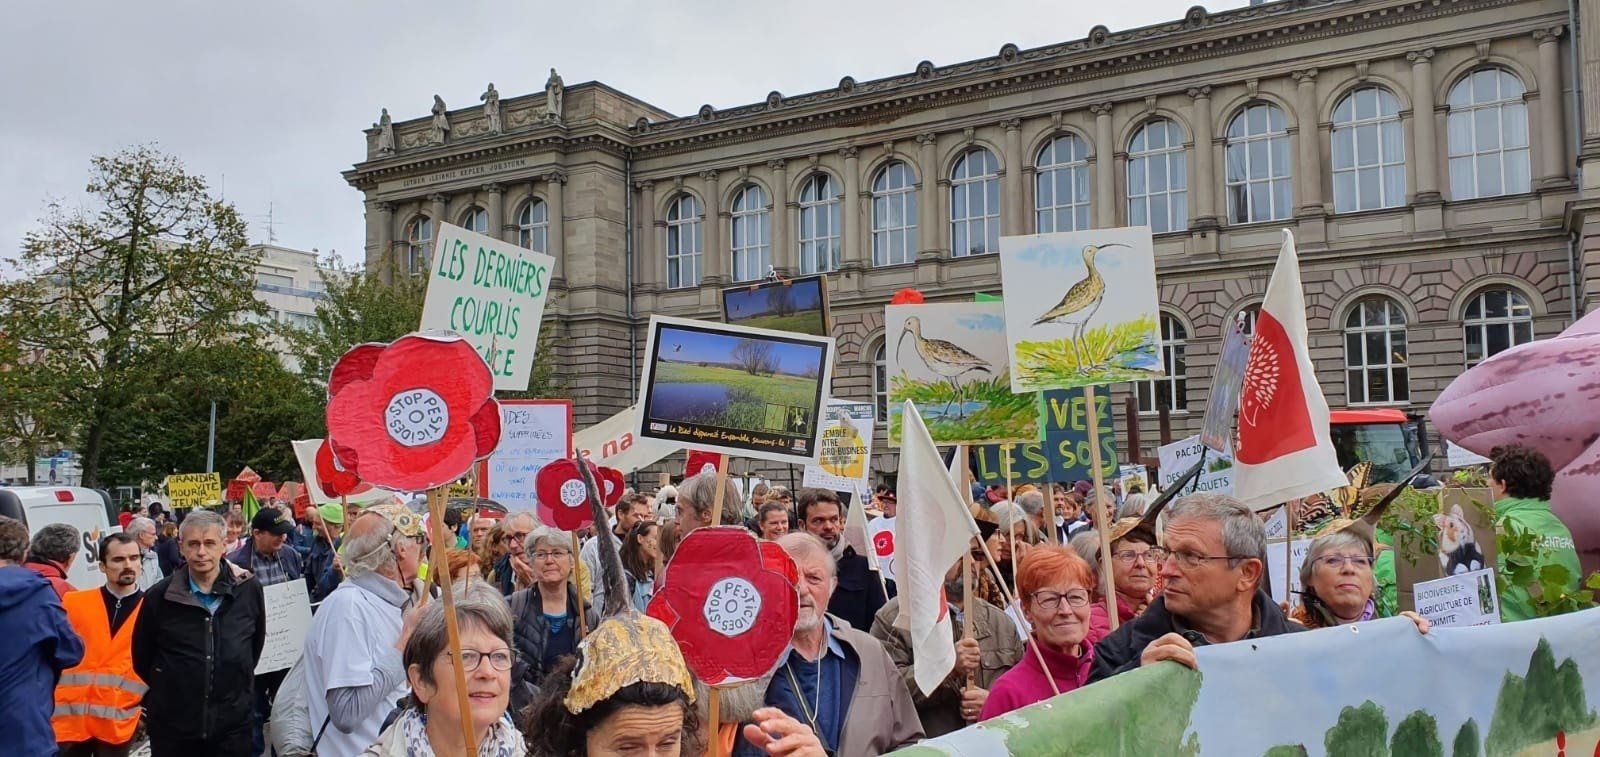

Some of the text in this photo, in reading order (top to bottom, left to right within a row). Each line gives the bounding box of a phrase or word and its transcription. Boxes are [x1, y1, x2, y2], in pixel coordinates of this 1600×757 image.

[460, 166, 485, 176] KEPLER
[438, 239, 546, 298] LES DERNIERS
[450, 296, 520, 340] COURLIS
[476, 345, 515, 377] ACE
[389, 392, 423, 416] STOP
[1045, 395, 1113, 434] VEZ
[669, 424, 677, 433] Le
[820, 446, 869, 457] GRO-BUSINESS
[979, 443, 1050, 480] LES
[1059, 436, 1118, 478] SOS
[1175, 446, 1191, 460] PAC
[169, 473, 216, 484] GRANDIR
[194, 481, 219, 491] VITE
[1184, 476, 1229, 496] BQUETS
[170, 488, 207, 497] MOURIR
[1417, 584, 1459, 600] BIODIVERSITE
[708, 588, 723, 623] STOP
[1419, 596, 1473, 616] AGRICULTURE DE
